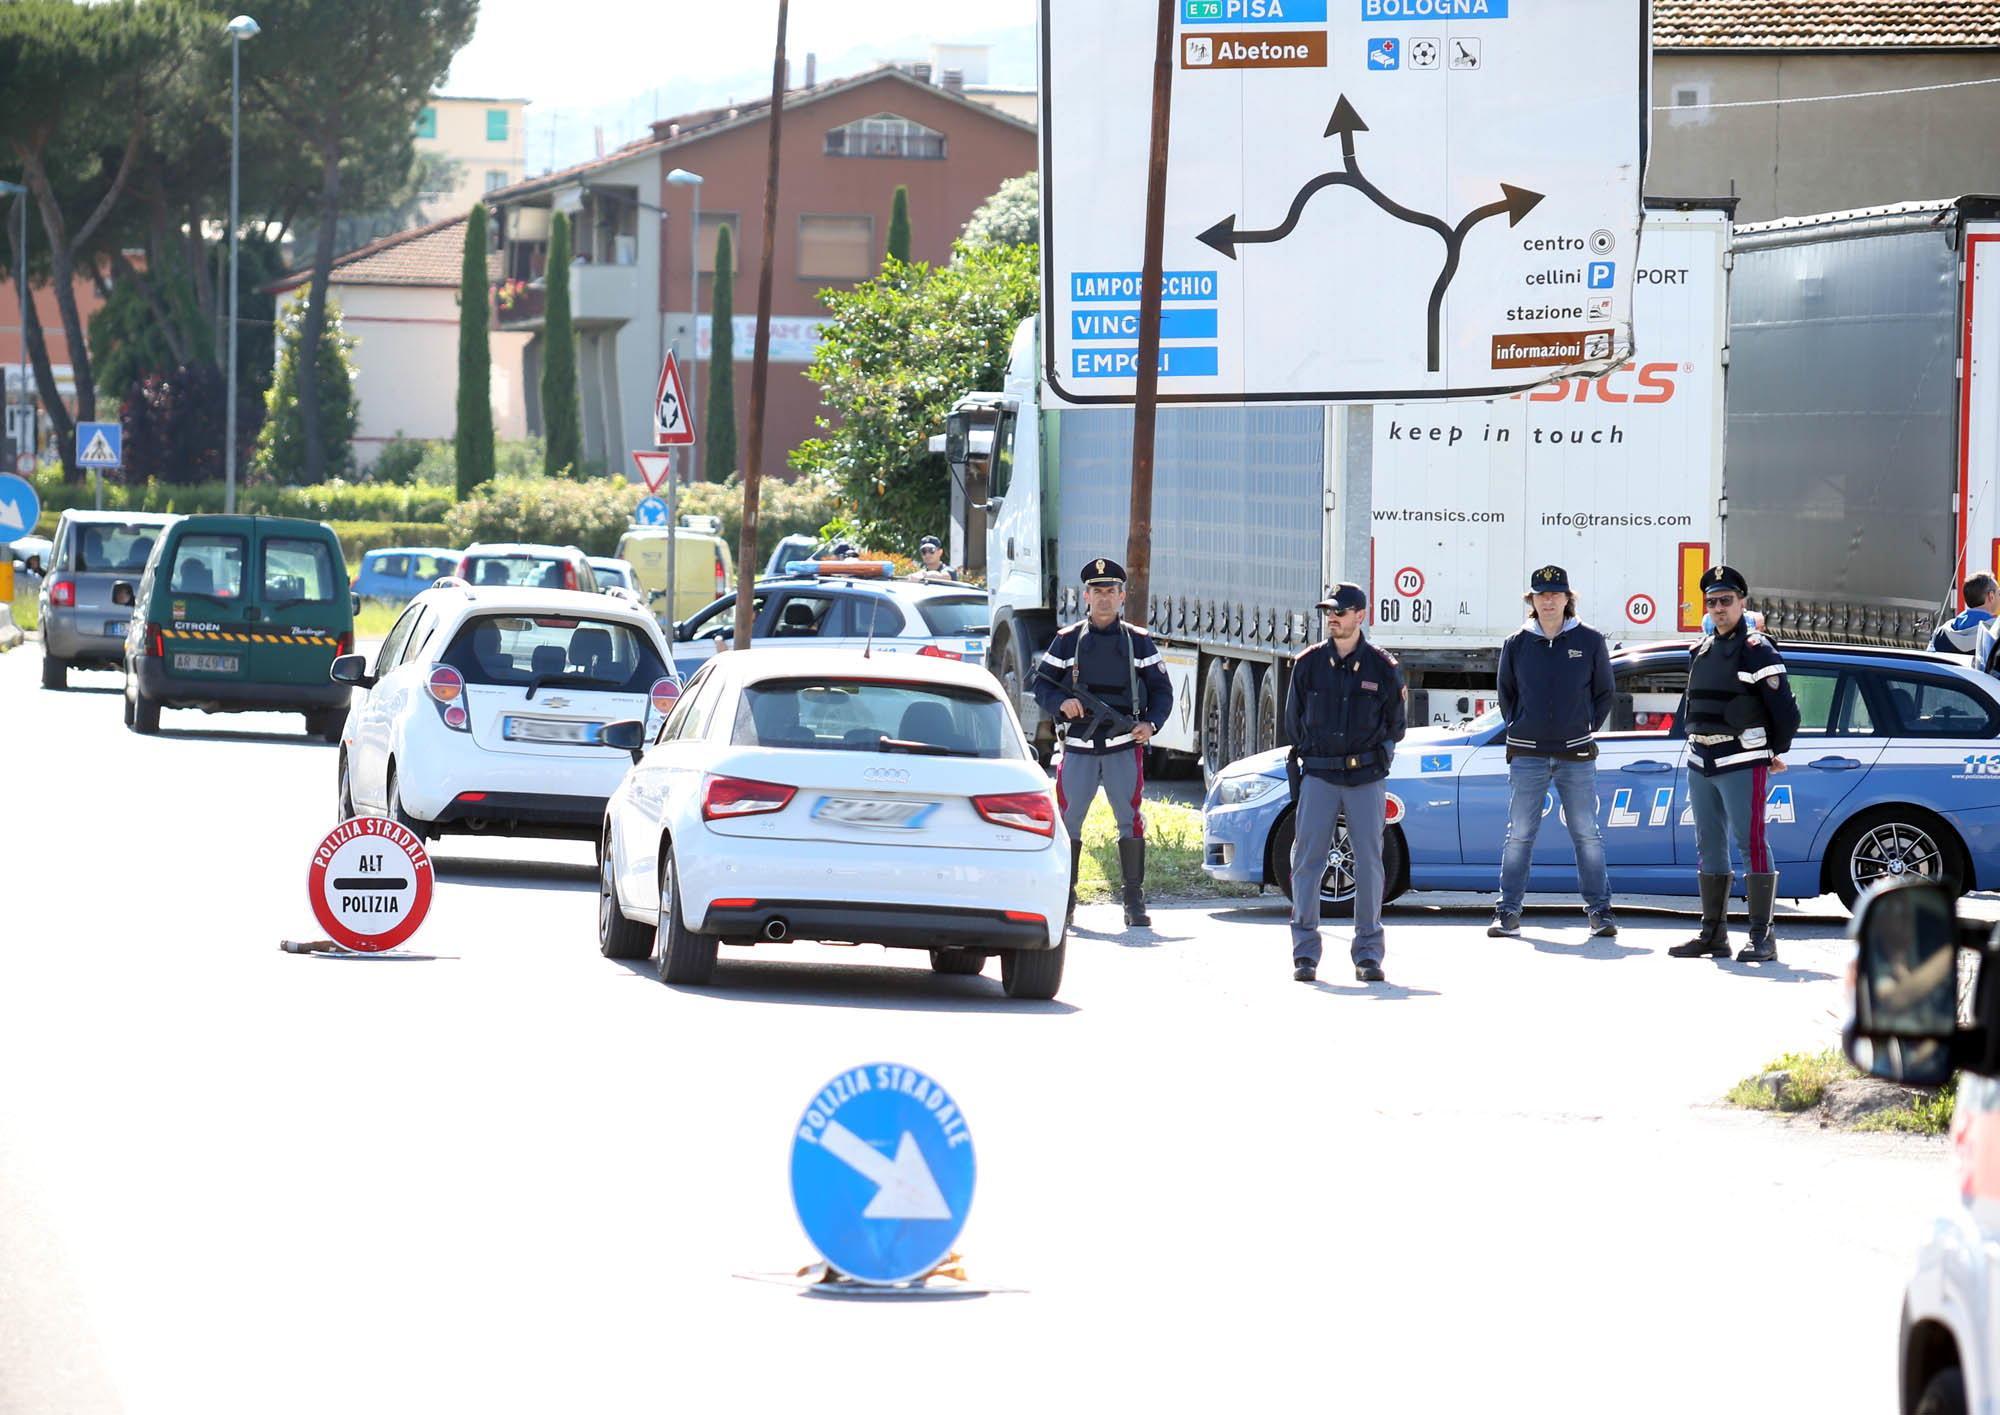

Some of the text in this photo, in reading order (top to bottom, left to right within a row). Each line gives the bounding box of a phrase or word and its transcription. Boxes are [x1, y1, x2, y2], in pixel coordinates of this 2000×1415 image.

[1190, 0, 1284, 18] E 76 PISA
[1366, 0, 1489, 16] BOLOGNA
[1217, 41, 1309, 61] Abetone
[1523, 236, 1584, 251] centro
[1526, 264, 1610, 287] cellini P
[1637, 269, 1689, 285] PORT
[1506, 305, 1583, 321] stazione
[1077, 315, 1138, 335] VINC
[1496, 341, 1581, 360] informazioni
[1389, 421, 1624, 447] keep in touch
[1541, 512, 1692, 529] info@transics.com
[1402, 575, 1418, 588] 70
[1380, 598, 1433, 624] 60 80
[1633, 602, 1649, 616] 80
[313, 819, 429, 871] POLIZIA STRADALE
[358, 854, 384, 872] ALT
[342, 896, 399, 913] POLIZIA
[799, 1064, 970, 1149] POLIZIA STRADALE
